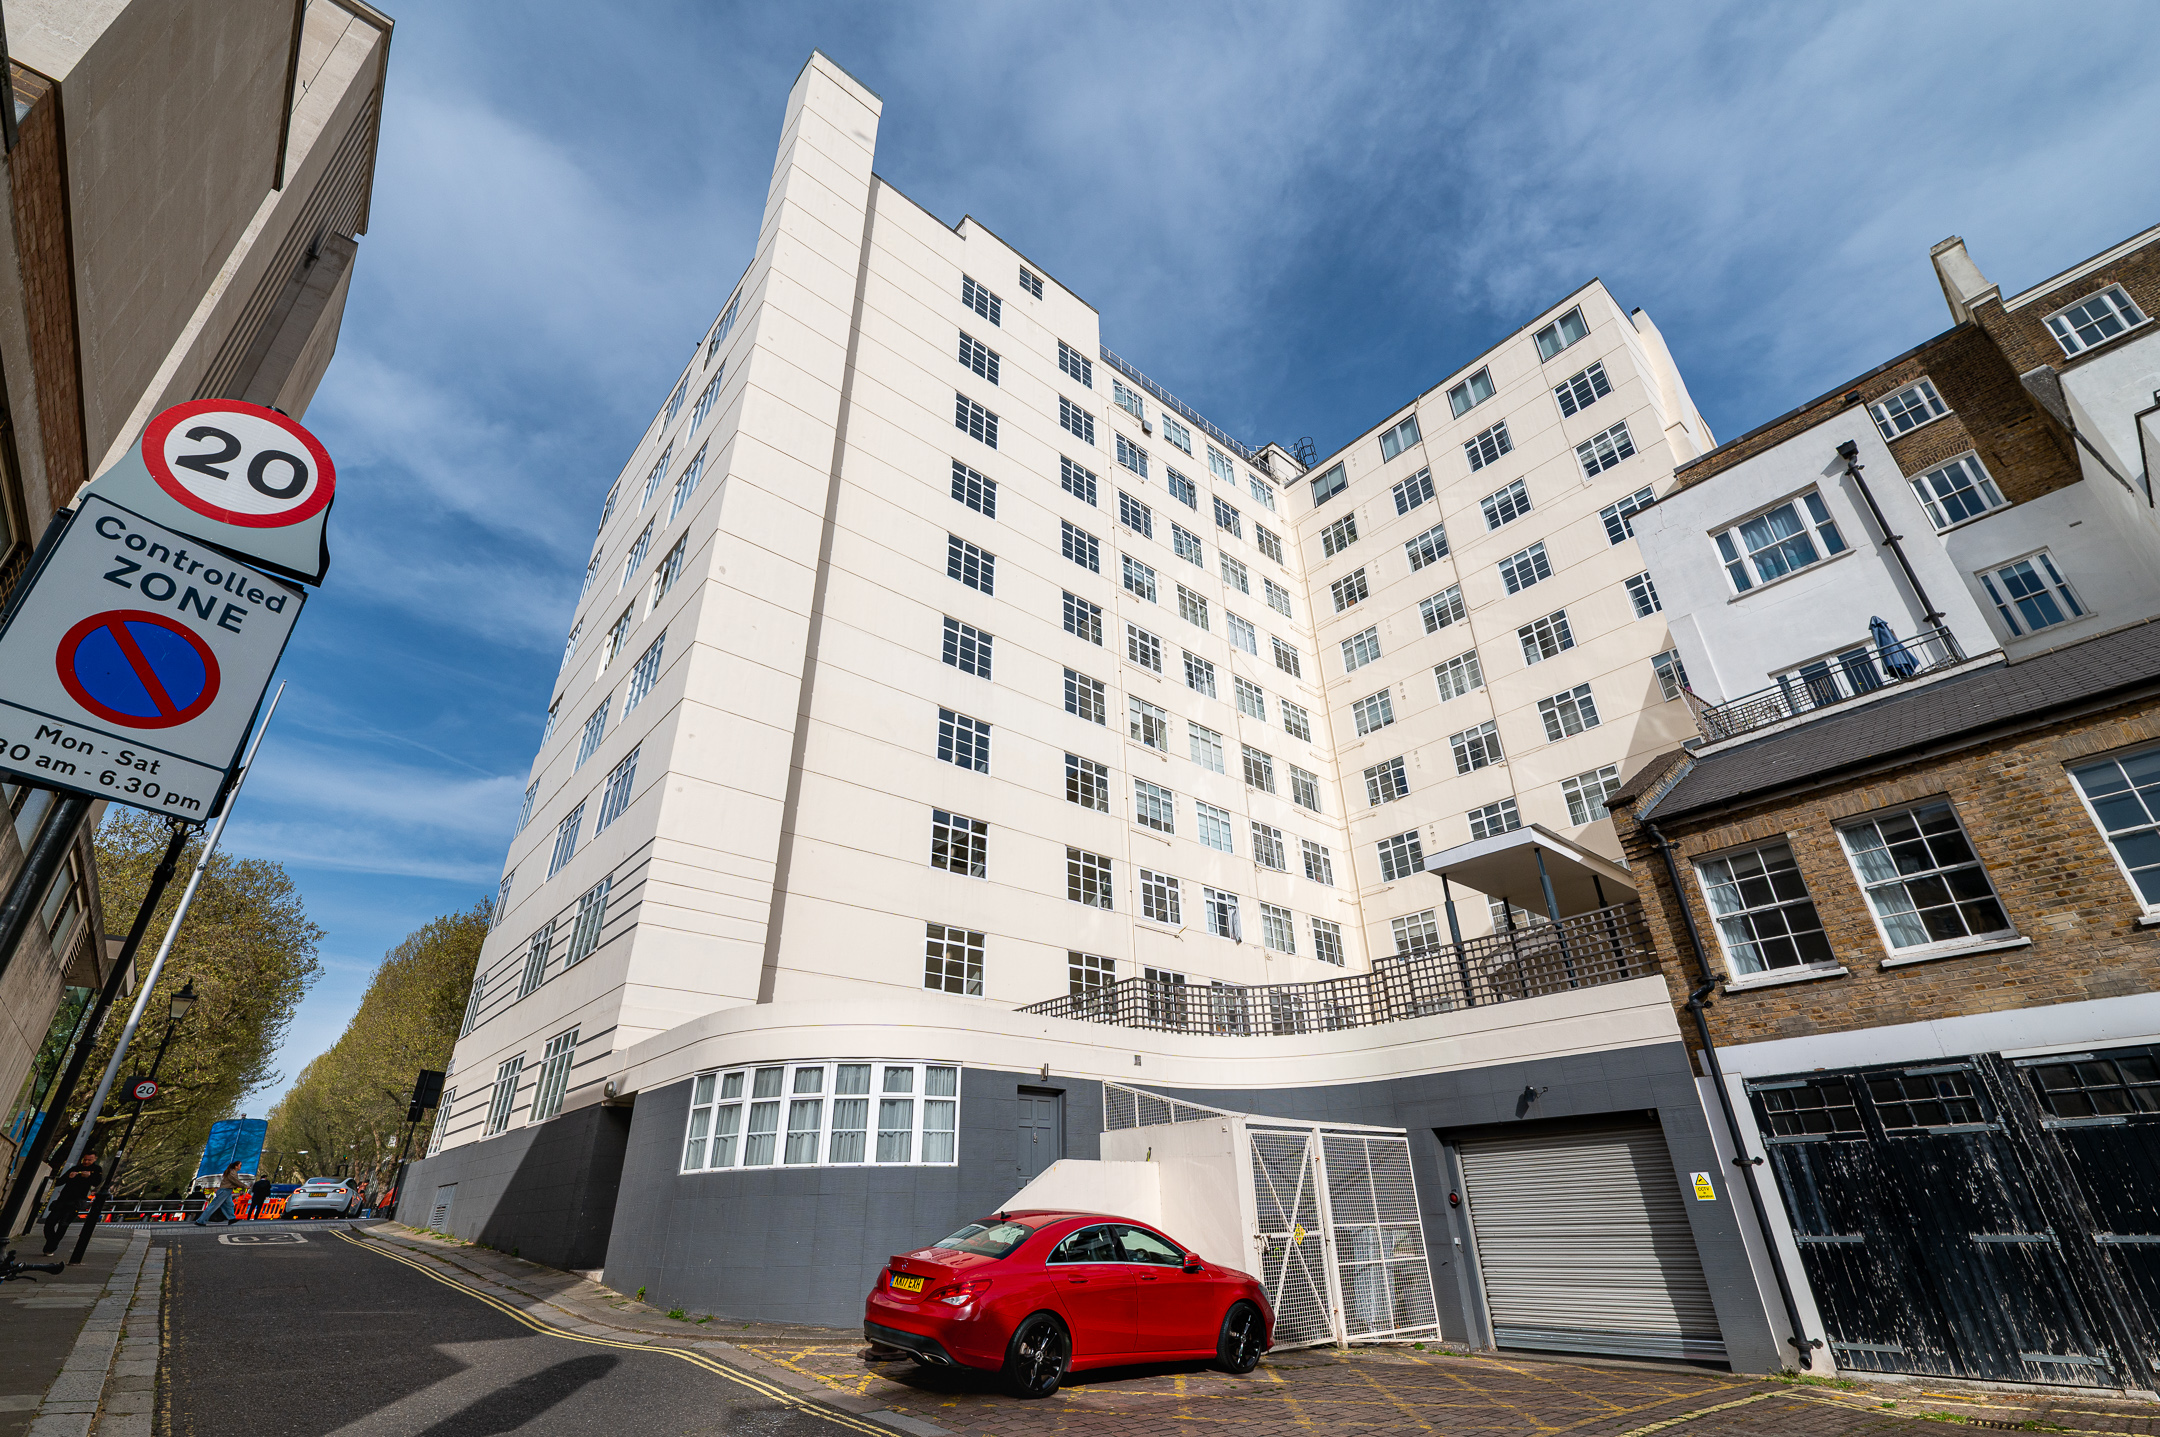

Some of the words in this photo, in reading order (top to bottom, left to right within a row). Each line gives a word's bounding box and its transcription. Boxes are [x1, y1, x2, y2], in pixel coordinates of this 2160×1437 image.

[174, 426, 309, 500] 20
[95, 515, 288, 615] Controlled
[103, 554, 249, 635] ZONE
[34, 724, 94, 756] Mon
[115, 750, 161, 776] Sat
[35, 755, 77, 776] am
[99, 769, 161, 799] 6.30
[162, 791, 201, 812] pm
[137, 1085, 155, 1095] 20
